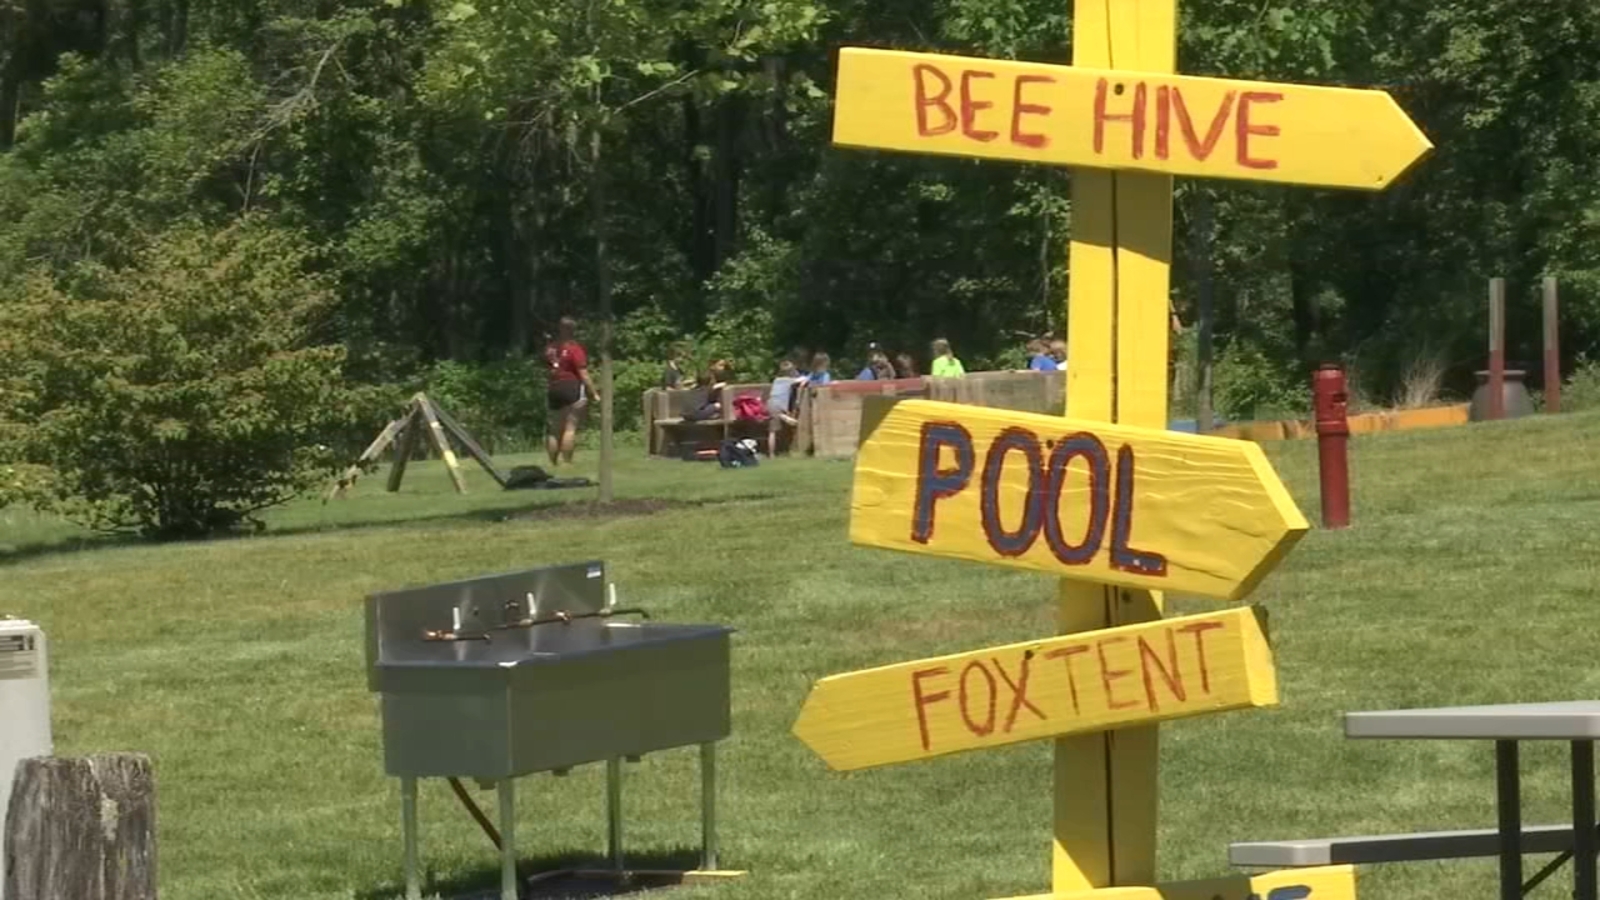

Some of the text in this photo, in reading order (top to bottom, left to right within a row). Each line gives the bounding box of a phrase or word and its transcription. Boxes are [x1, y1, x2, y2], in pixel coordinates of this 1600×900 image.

[913, 63, 1284, 169] BEE HIVE
[911, 420, 1168, 576] POOL
[912, 621, 1224, 751] FOX TENT
